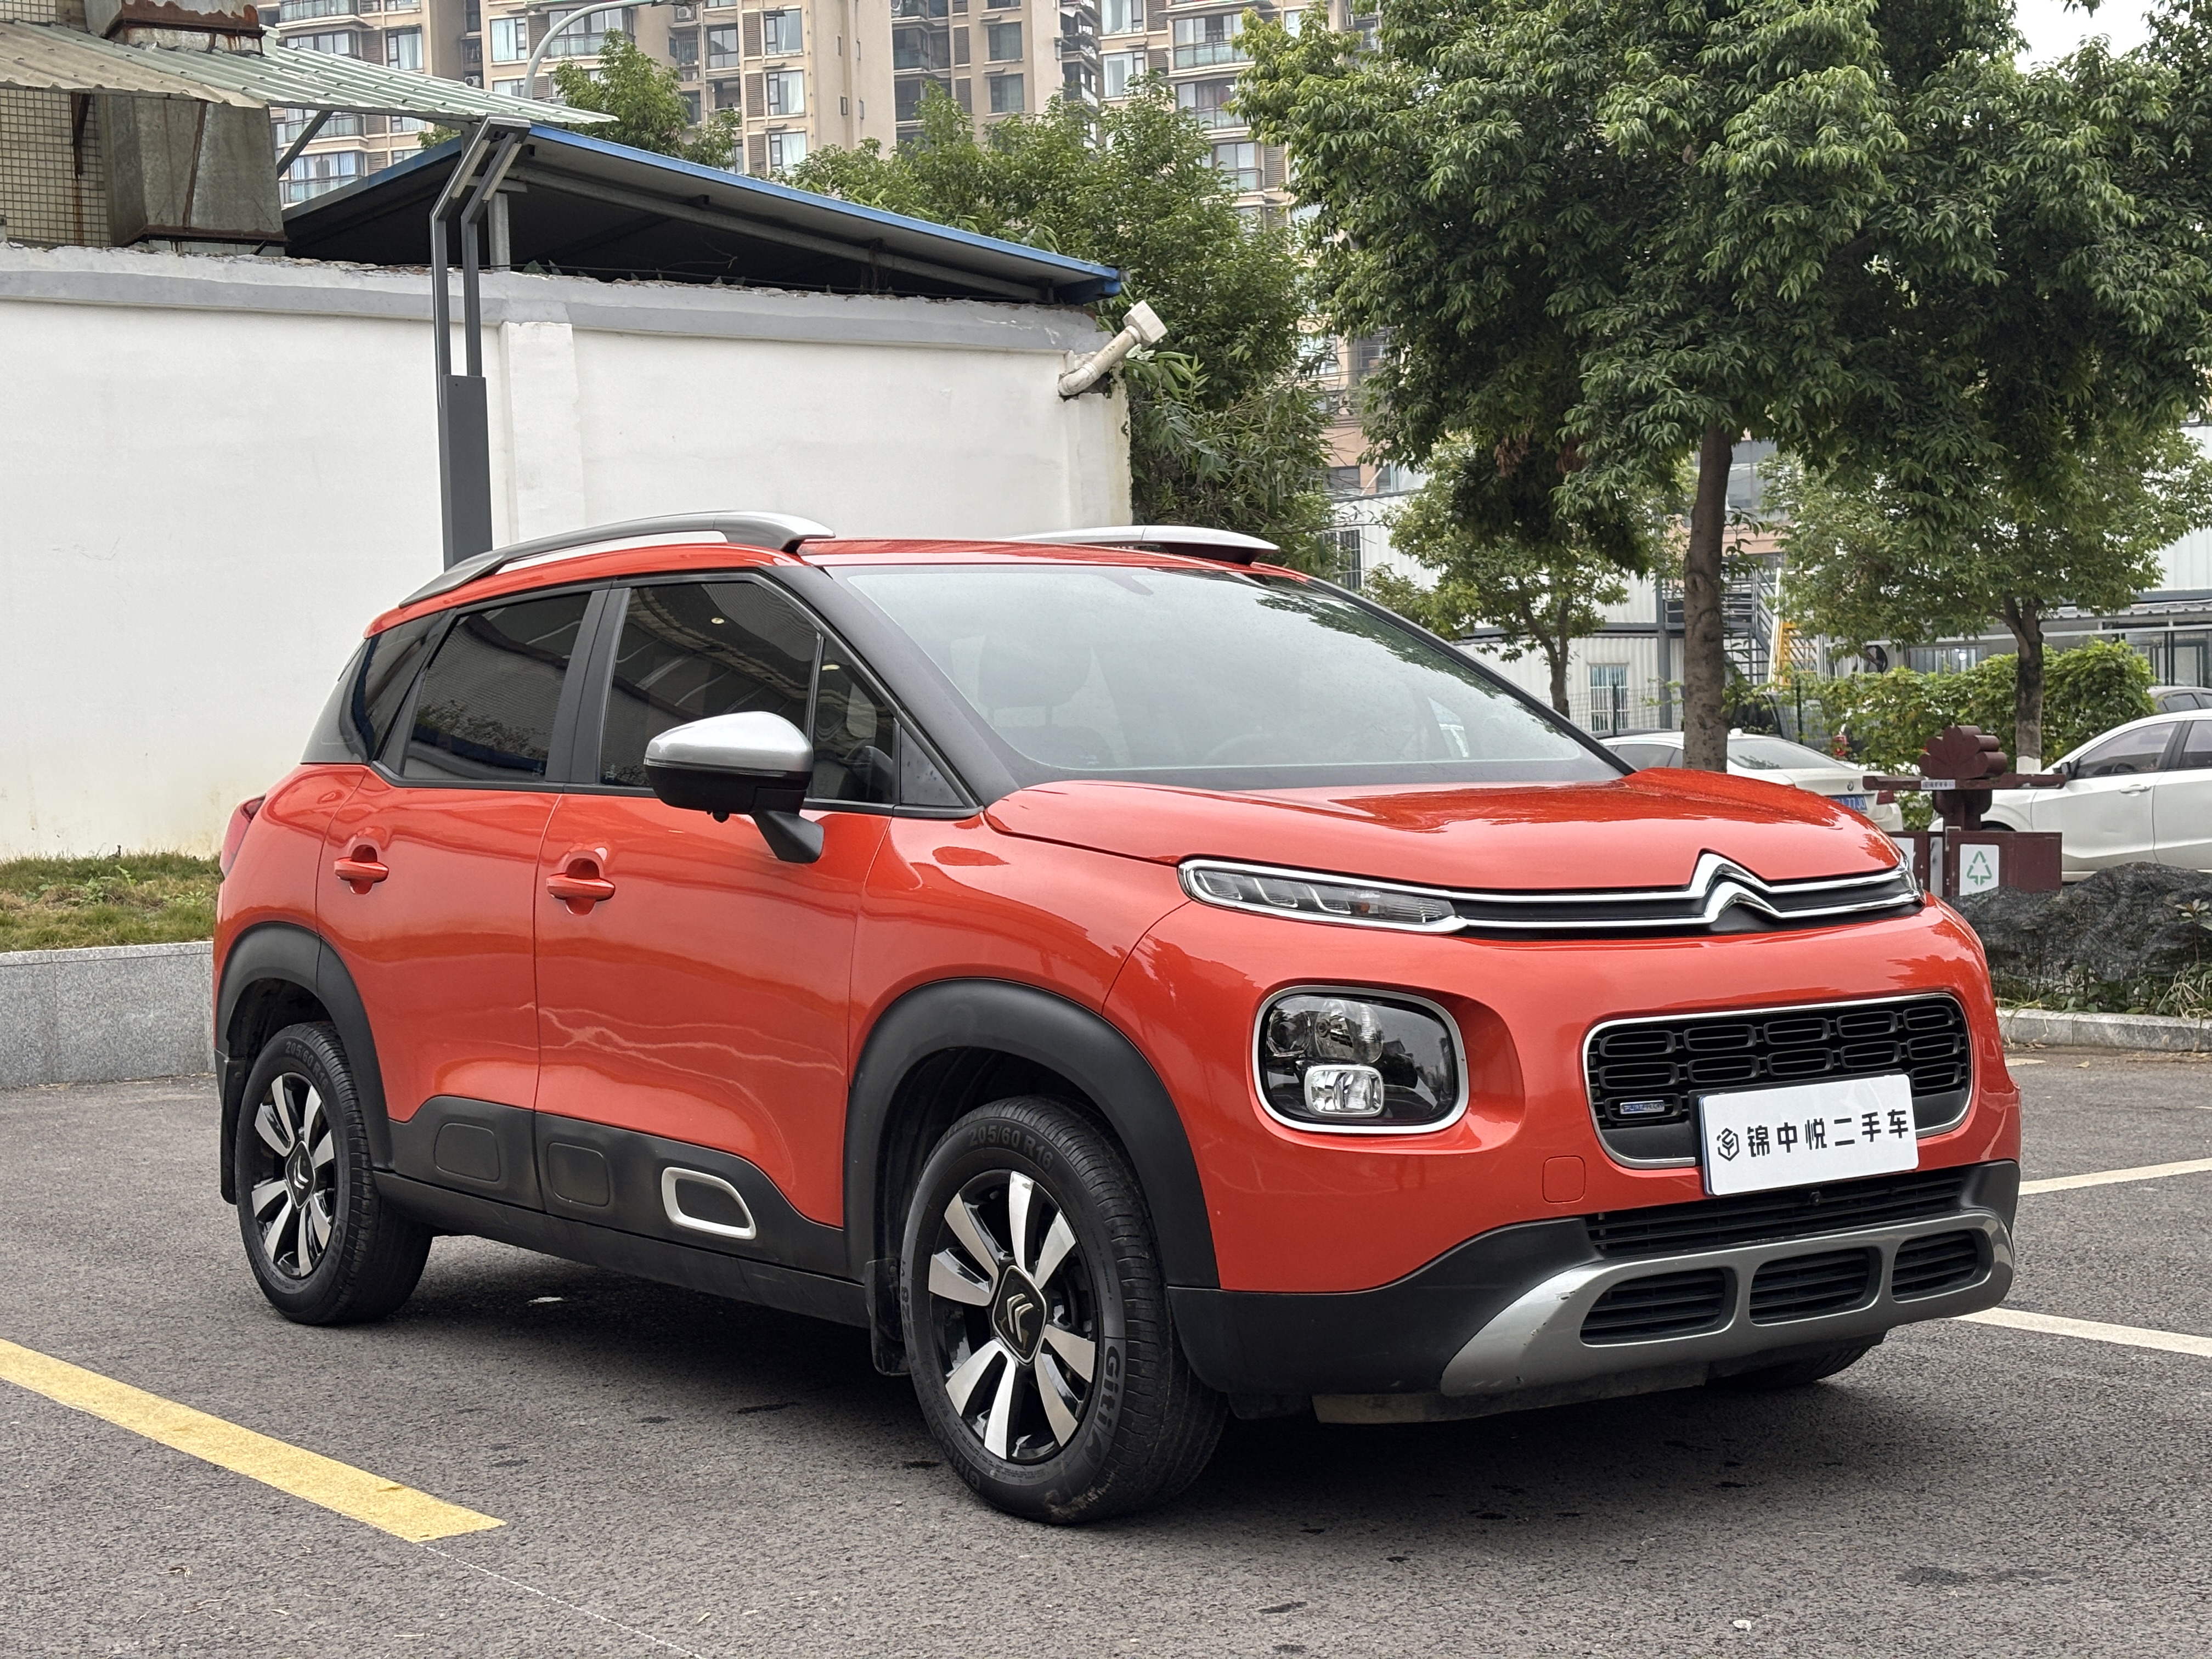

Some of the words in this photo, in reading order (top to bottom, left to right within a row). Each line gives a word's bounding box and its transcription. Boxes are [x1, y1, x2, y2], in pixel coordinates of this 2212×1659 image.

[285, 1041, 314, 1068] 205/60
[312, 1061, 329, 1091] R16
[969, 1125, 1020, 1148] 205/60
[1023, 1135, 1053, 1170] R16
[1747, 1109, 1909, 1158] 锦中悦二手车
[1098, 1346, 1121, 1427] Giti
